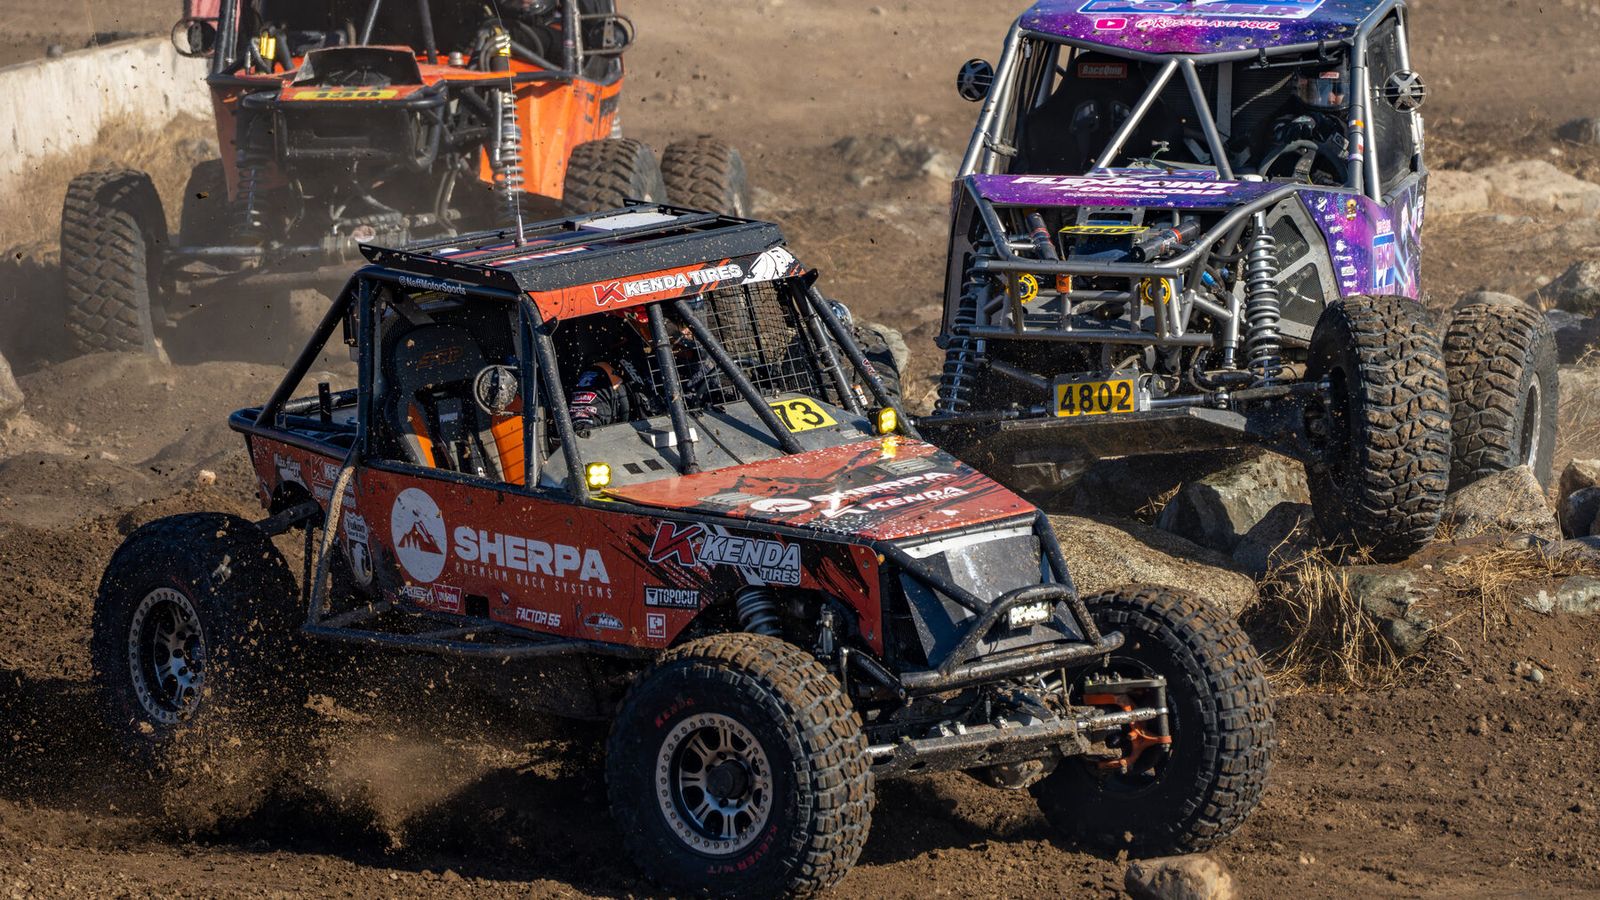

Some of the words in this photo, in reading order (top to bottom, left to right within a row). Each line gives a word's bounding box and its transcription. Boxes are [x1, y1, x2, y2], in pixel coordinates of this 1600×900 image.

[399, 275, 467, 296] @NeffMotorSports
[624, 273, 690, 297] KENDA
[688, 264, 743, 286] TIRES
[1060, 381, 1131, 415] 4802
[867, 486, 969, 510] KENDA
[453, 525, 611, 584] SHERPA
[699, 534, 800, 571] KENDA
[455, 562, 508, 582] PREMIUM
[516, 573, 545, 590] RACK
[554, 580, 613, 599] SYSTEMS
[760, 567, 799, 584] TIRES
[658, 588, 699, 605] TOPOCUT
[515, 606, 547, 625] FACTOR
[548, 613, 562, 627] 55
